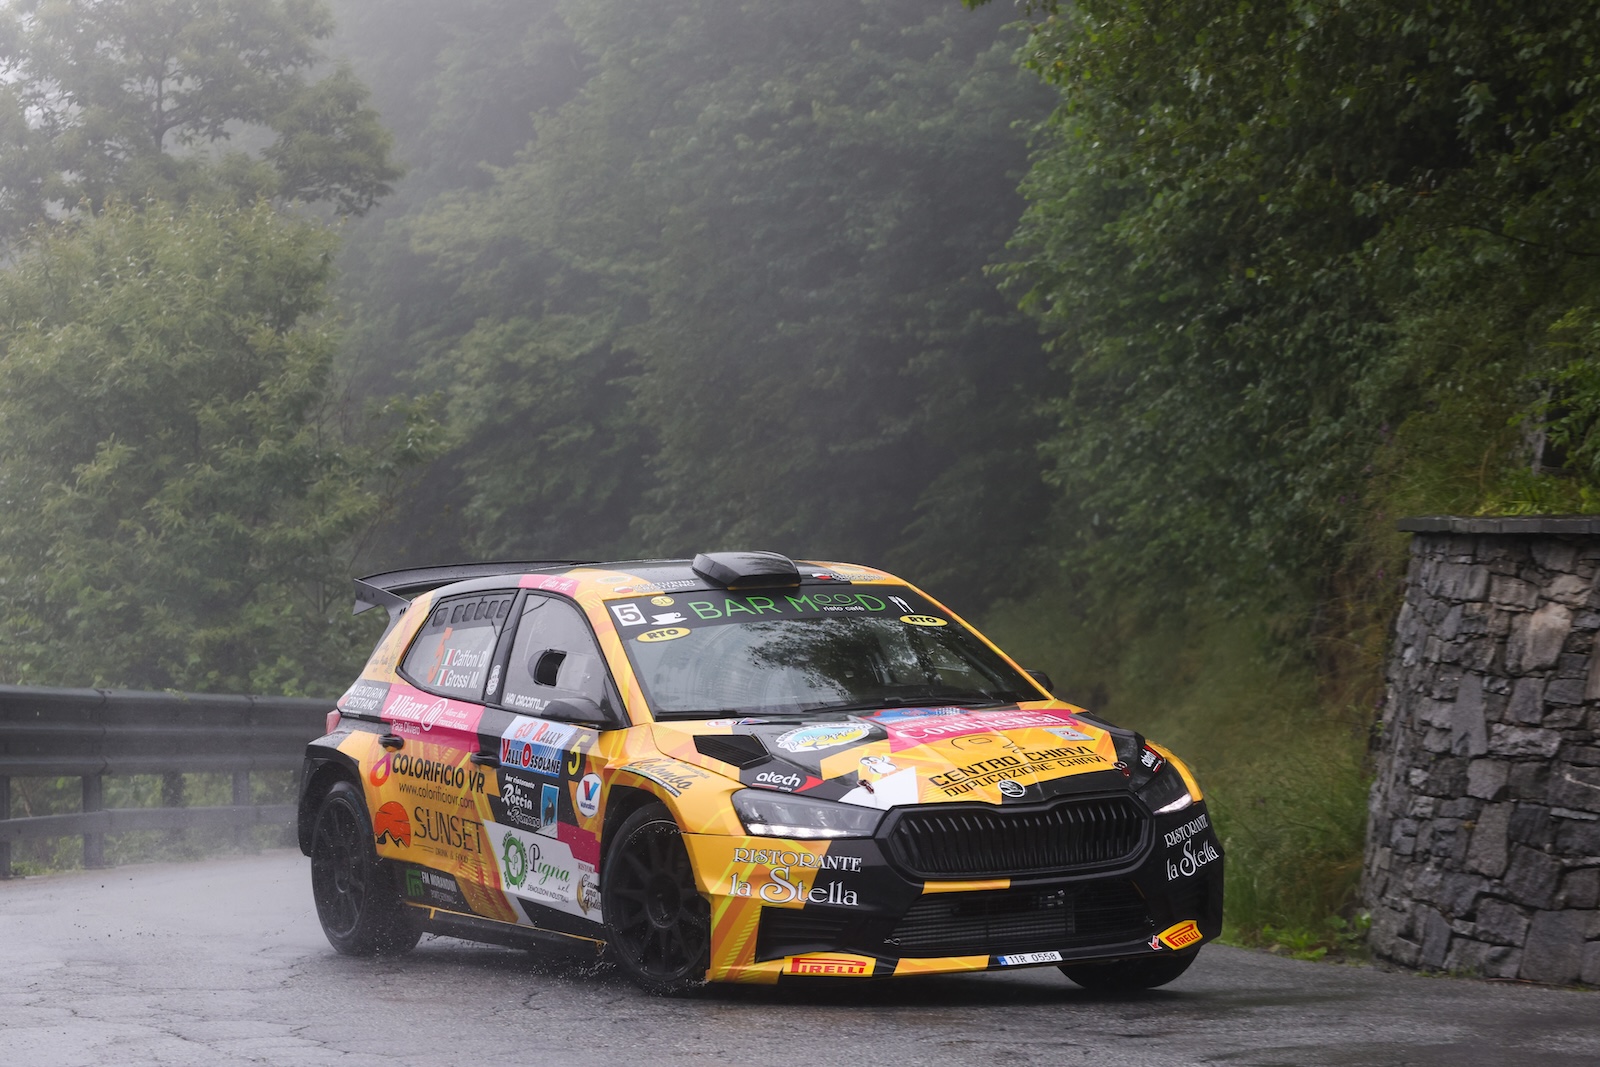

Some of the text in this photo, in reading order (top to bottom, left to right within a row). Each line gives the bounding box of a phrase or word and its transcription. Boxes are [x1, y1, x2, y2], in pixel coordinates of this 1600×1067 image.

[618, 606, 641, 622] 5
[687, 597, 783, 620] BAR
[908, 615, 937, 625] RTO
[646, 629, 679, 640] RTO
[452, 649, 480, 667] Caffoni
[445, 669, 471, 688] Grossi
[384, 694, 429, 720] Allianz
[392, 719, 421, 736] Pace Oliviero
[532, 722, 563, 746] RALLY
[895, 712, 1069, 740] Continental
[568, 734, 592, 775] 5
[928, 745, 1096, 787] CENTRO CHIAVI
[392, 752, 485, 793] COLORIFICIO VR
[755, 771, 801, 787] atech
[944, 755, 1107, 797] DUPLICAZIONE CHIAVI
[398, 783, 475, 809] www.colorificiovr.com
[501, 783, 533, 810] Roccia
[515, 785, 521, 795] la
[414, 806, 484, 854] SUNSET
[1164, 814, 1208, 849] RISTORANTE
[528, 843, 570, 885] Pigna
[733, 848, 862, 873] RISTORANTE
[1166, 838, 1219, 881] la Stella
[729, 866, 859, 906] la Stella
[1165, 923, 1200, 947] PIRELLI
[792, 957, 866, 974] PIRELLI
[1008, 952, 1057, 964] 11R 0558
